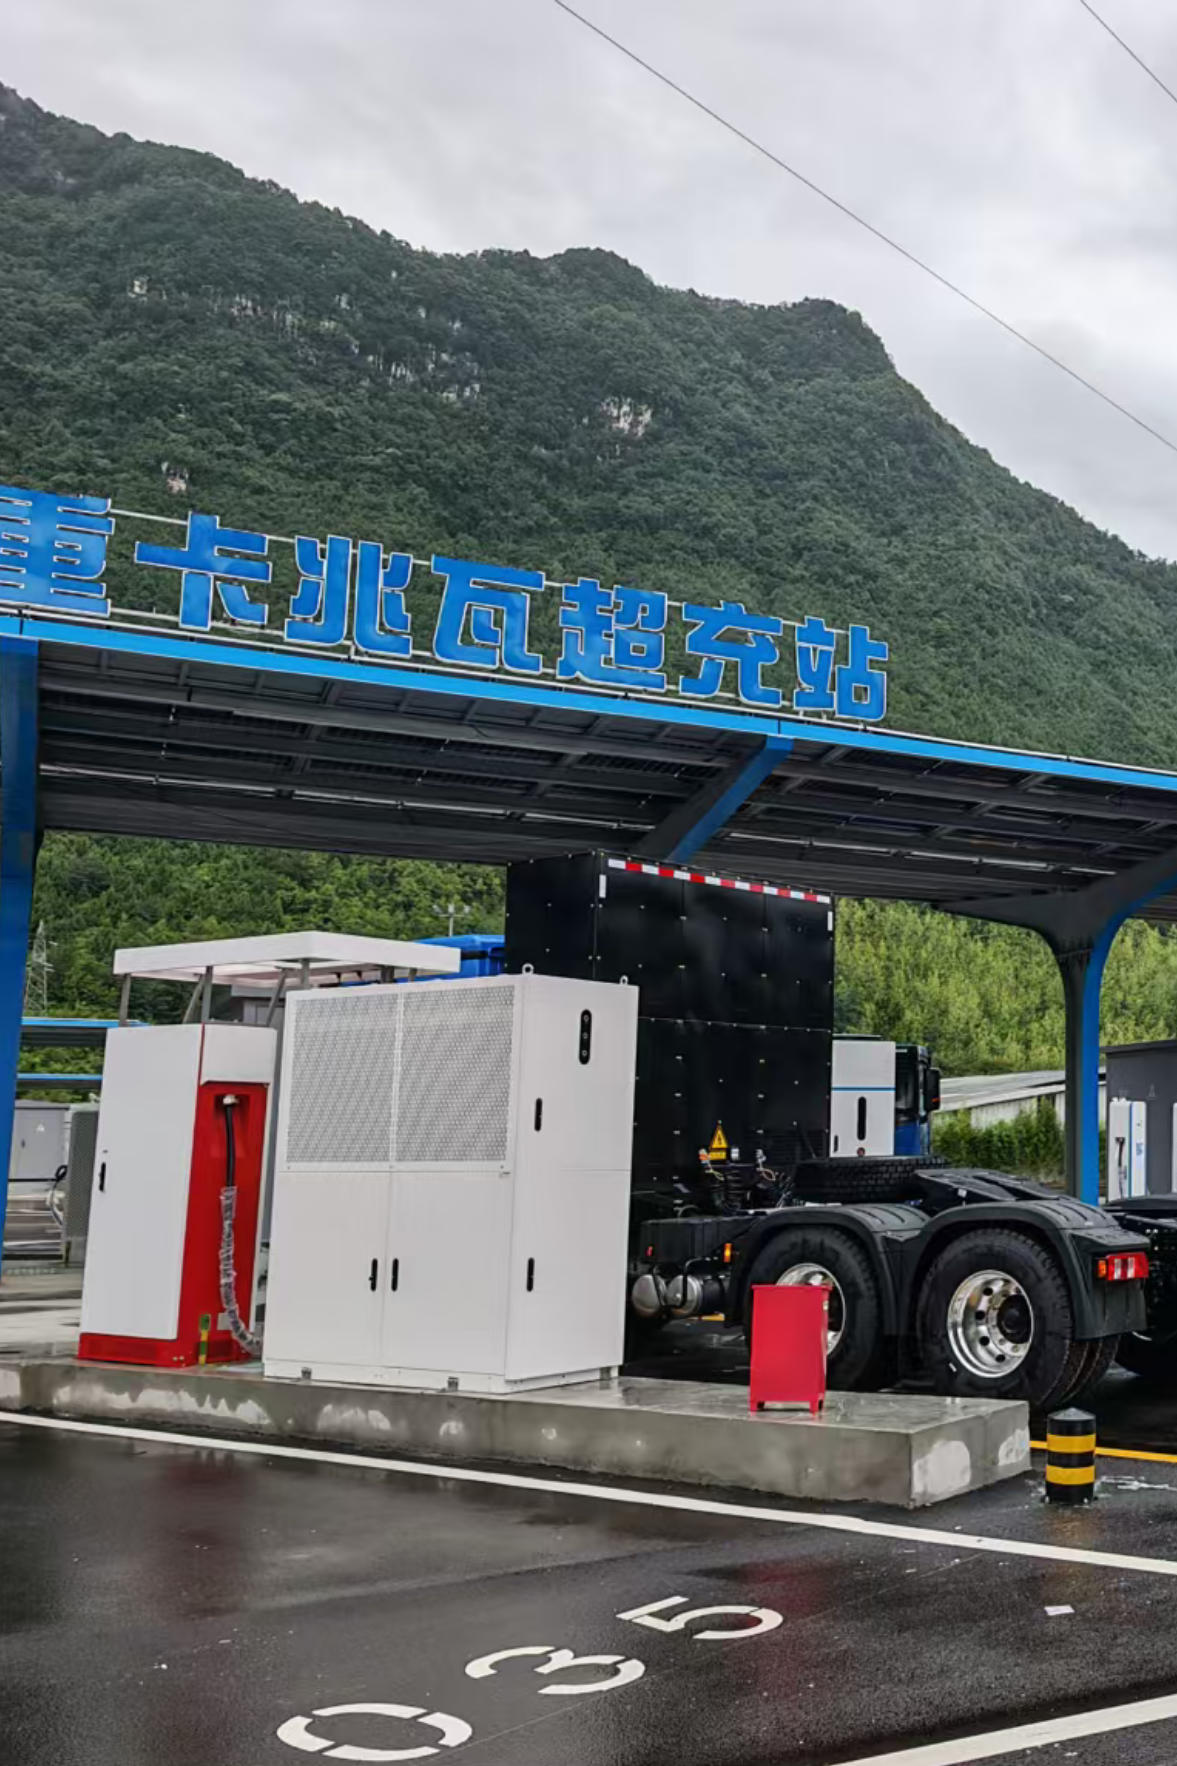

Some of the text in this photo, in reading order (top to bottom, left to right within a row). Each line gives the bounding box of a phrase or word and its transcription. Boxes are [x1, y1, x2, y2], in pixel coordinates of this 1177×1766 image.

[0, 485, 887, 721] 重卡兆瓦超充站
[276, 1596, 783, 1761] 035
